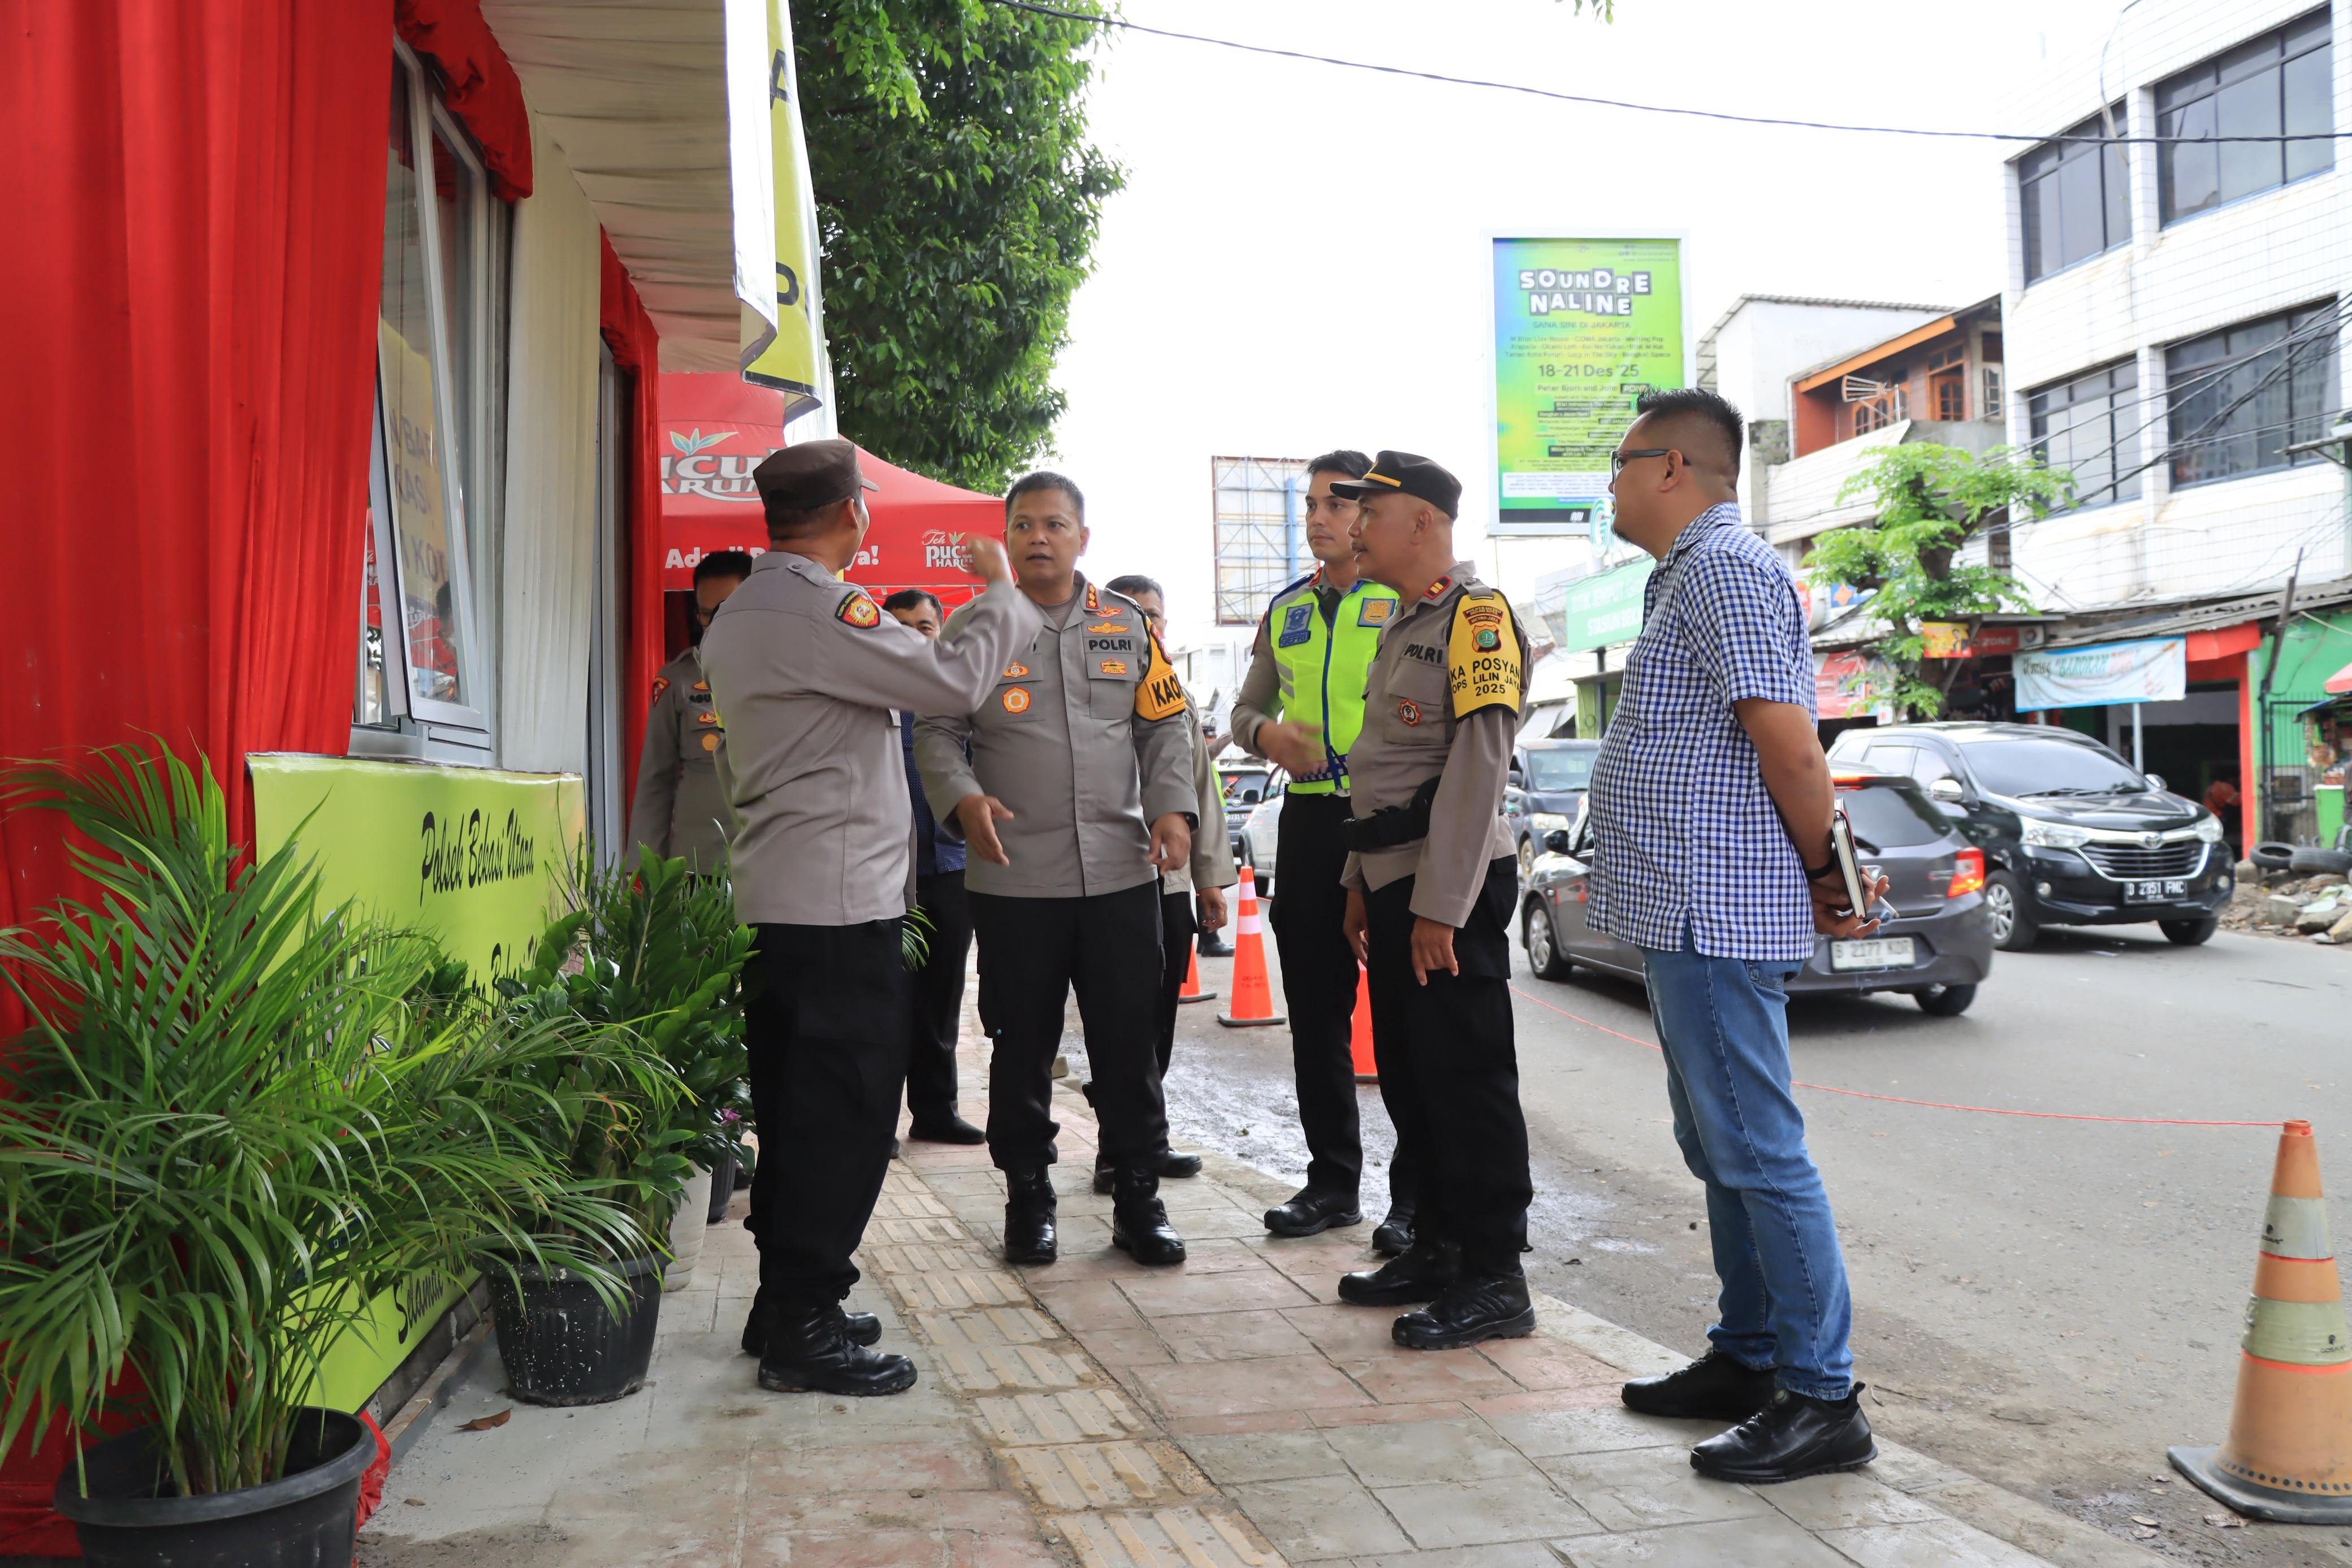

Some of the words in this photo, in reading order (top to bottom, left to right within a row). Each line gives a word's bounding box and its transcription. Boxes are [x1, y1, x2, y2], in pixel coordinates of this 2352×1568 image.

[1519, 269, 1650, 294] SOUNDRE
[1529, 292, 1632, 315] NALINE
[1538, 364, 1579, 377] 18-21
[1584, 364, 1614, 377] Des
[1616, 364, 1639, 377] '25
[922, 531, 946, 545] Teh
[1089, 639, 1131, 650] POLRI
[1983, 637, 2013, 647] ZONE
[1404, 643, 1443, 664] POLRI
[1450, 665, 1466, 682] KA
[1473, 657, 1520, 680] POSYAN
[1452, 679, 1467, 694] OPS
[1473, 672, 1499, 685] LILIN
[1504, 675, 1520, 691] JAYA
[1475, 683, 1506, 697] 2025
[420, 811, 464, 908] Polsek
[468, 808, 505, 889] Bekasi
[507, 807, 534, 880] Utara
